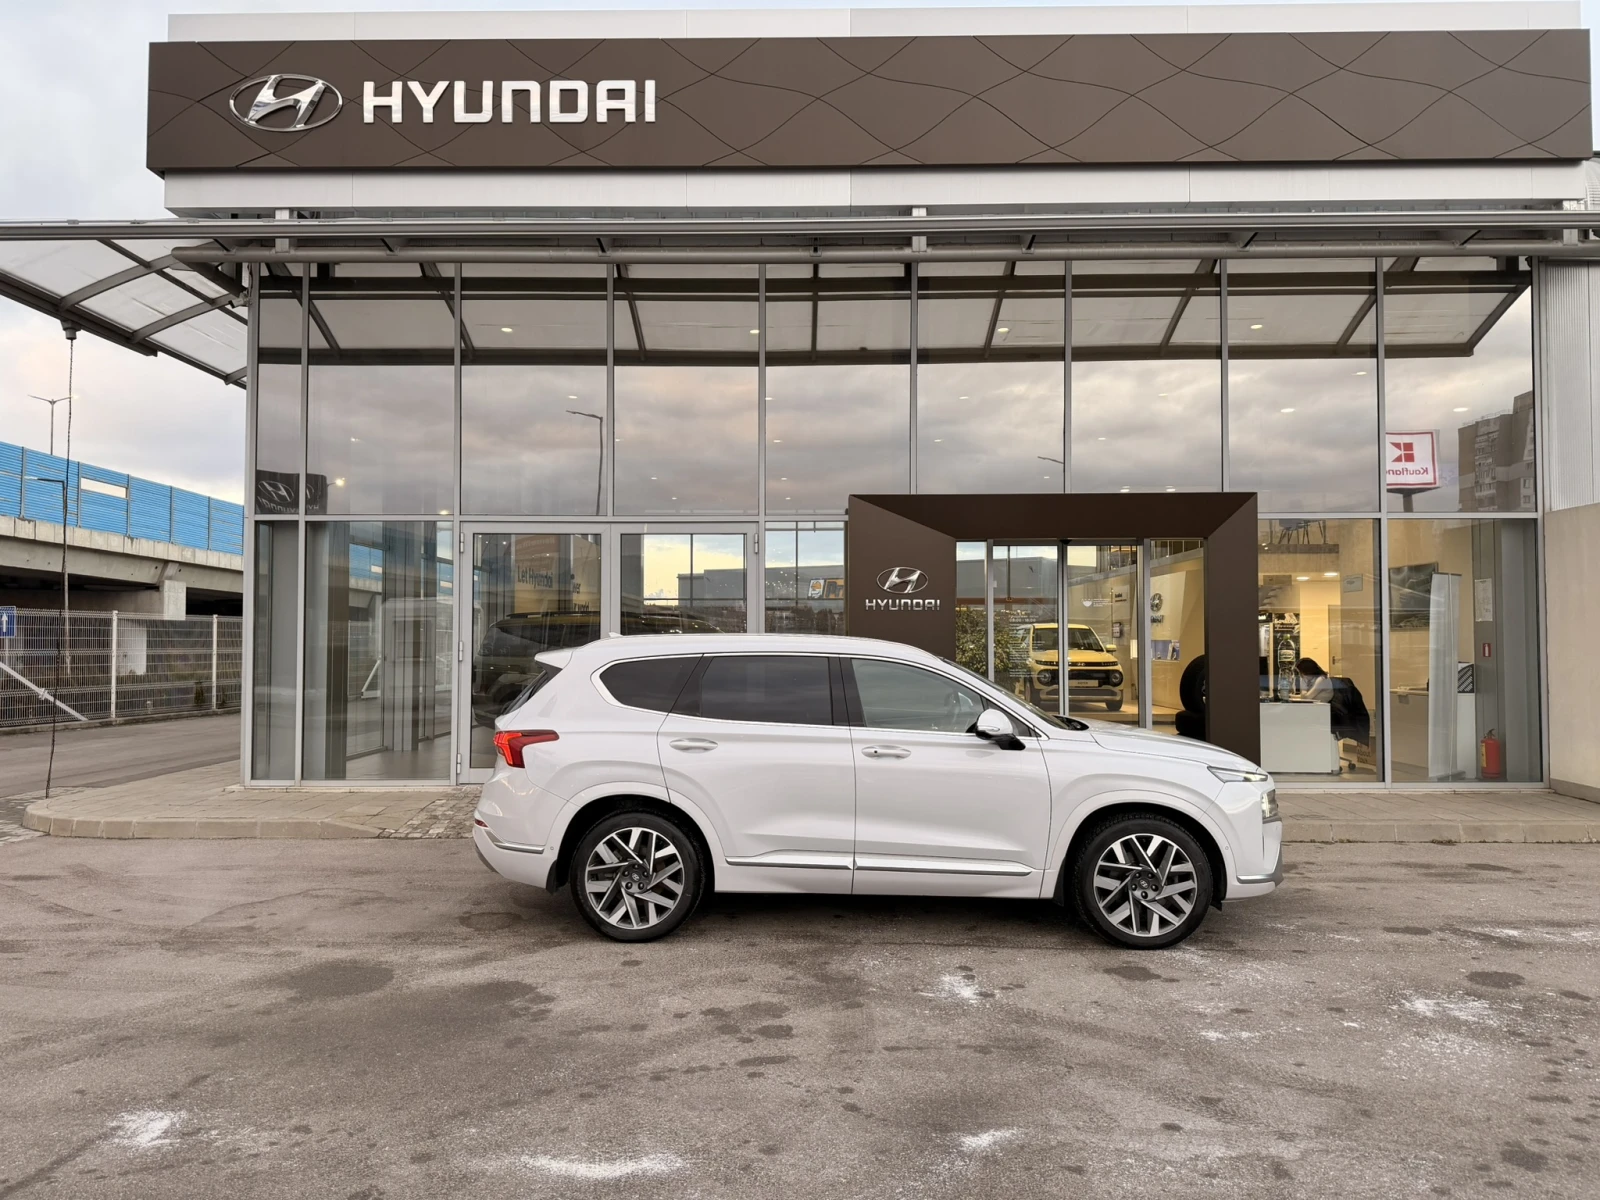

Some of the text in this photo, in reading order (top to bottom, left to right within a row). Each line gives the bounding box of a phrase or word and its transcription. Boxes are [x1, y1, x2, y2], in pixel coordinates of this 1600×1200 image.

[363, 79, 656, 124] HYUNDAI
[517, 565, 553, 590] Let Hyundai
[865, 599, 941, 611] HYUNDAI
